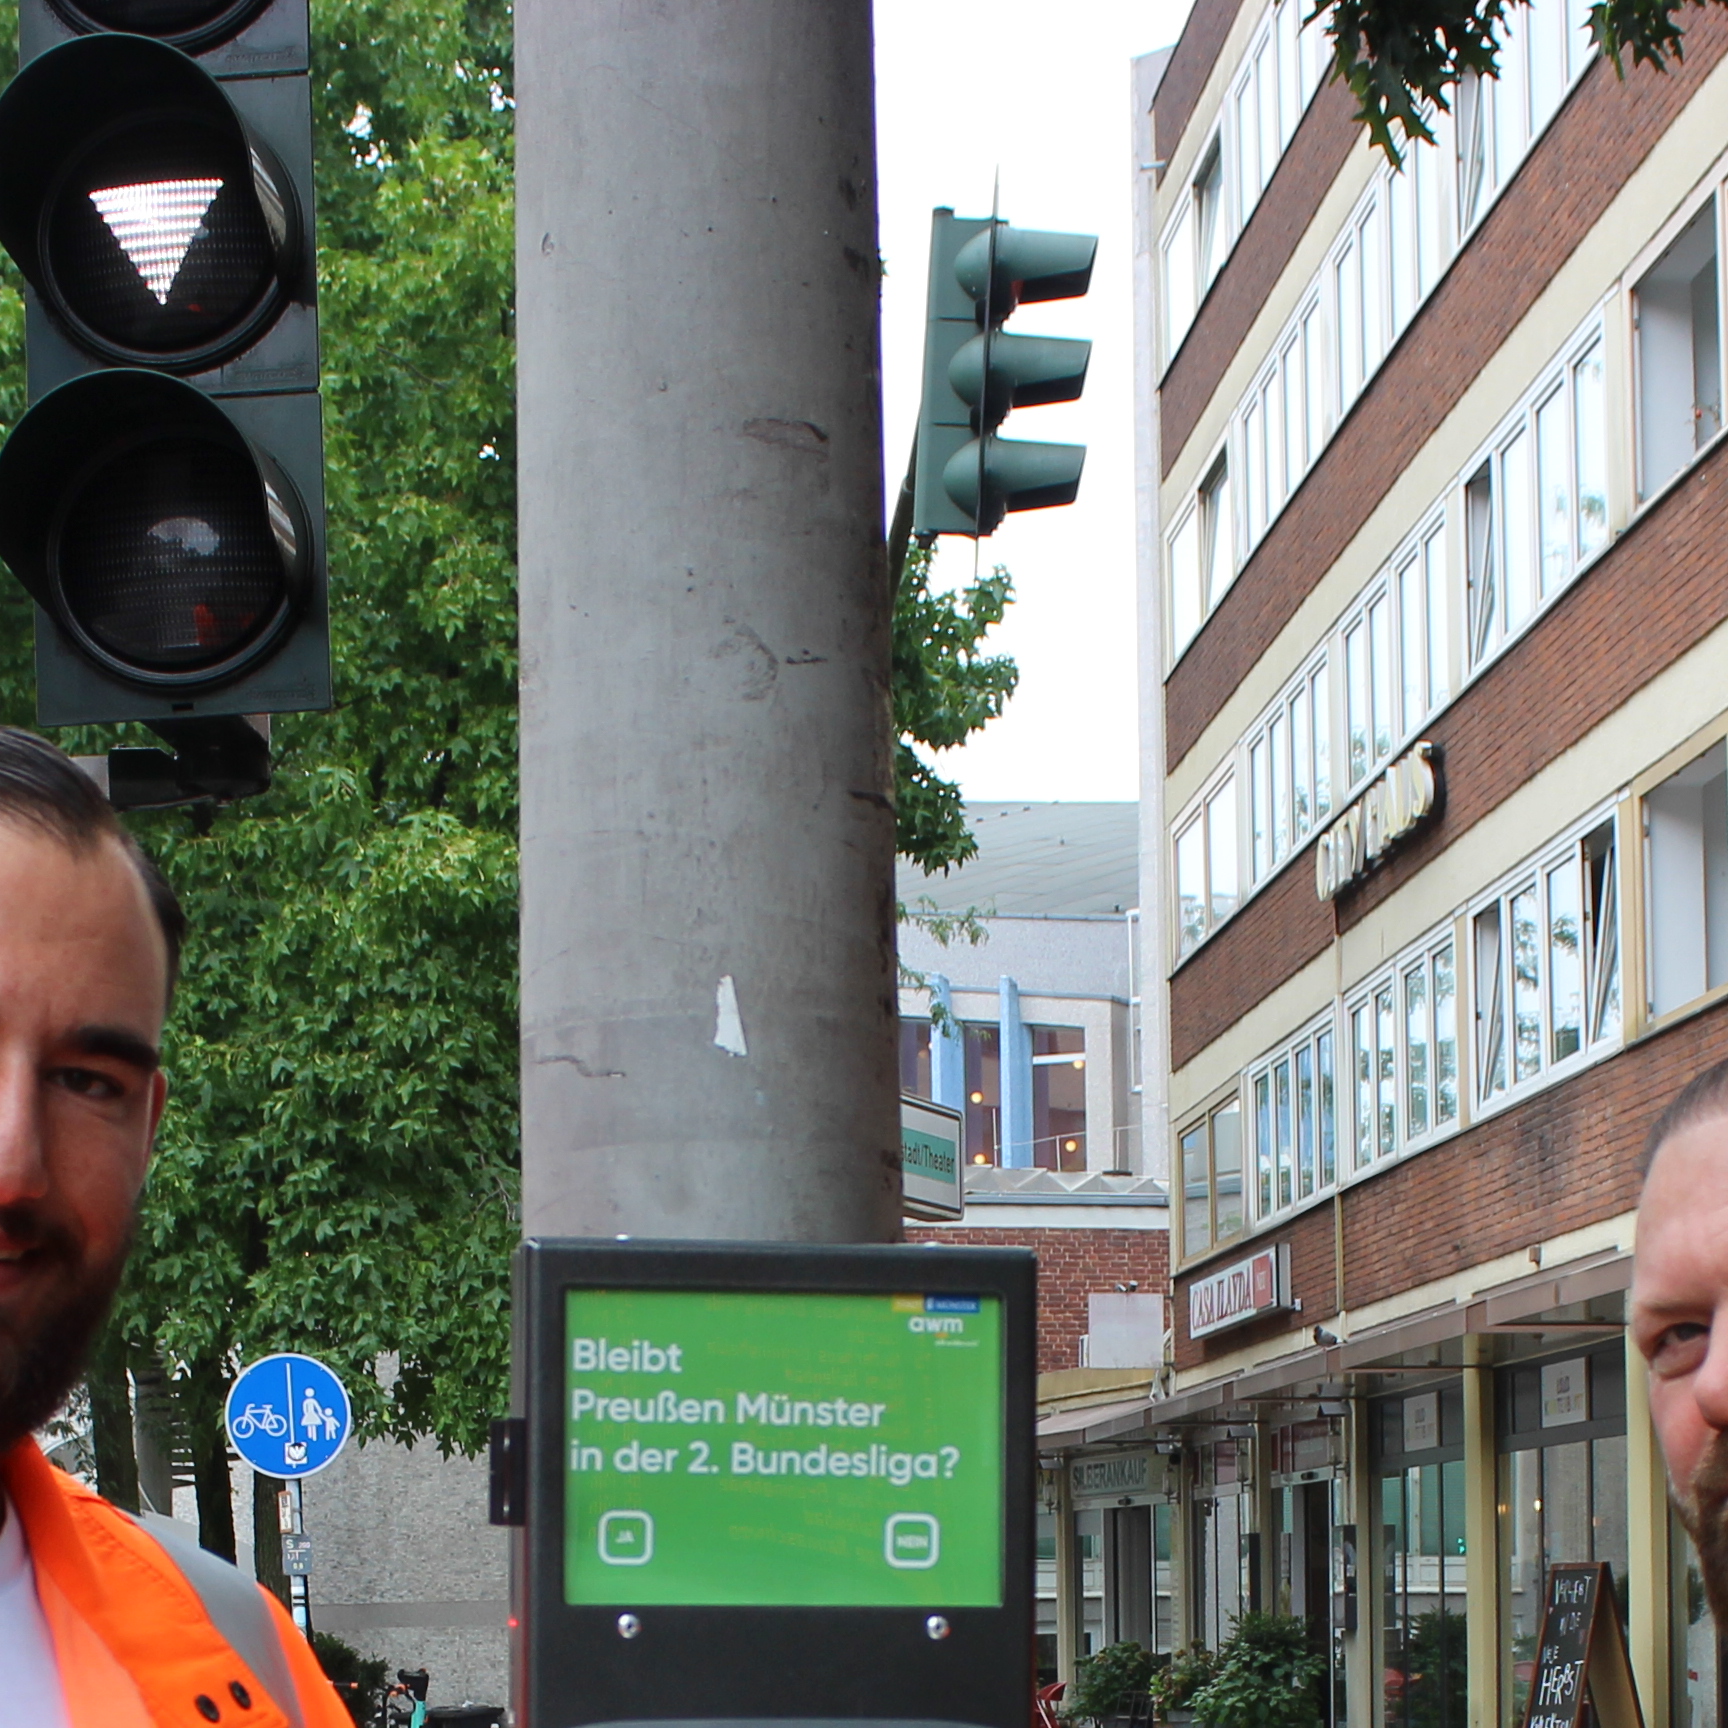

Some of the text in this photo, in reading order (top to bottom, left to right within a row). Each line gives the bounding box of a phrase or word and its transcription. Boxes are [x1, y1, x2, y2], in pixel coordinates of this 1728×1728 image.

[908, 1317, 963, 1333] awm
[1192, 1285, 1216, 1331] CASA
[573, 1337, 683, 1373] Bleibt
[572, 1388, 886, 1427] Preußen Münster
[571, 1438, 960, 1486] in der 2. Bundesliga?
[1074, 1457, 1148, 1490] SILBERANKAUF
[615, 1530, 635, 1544] JA
[896, 1535, 928, 1548] NEIN
[1539, 1660, 1585, 1706] HERBST
